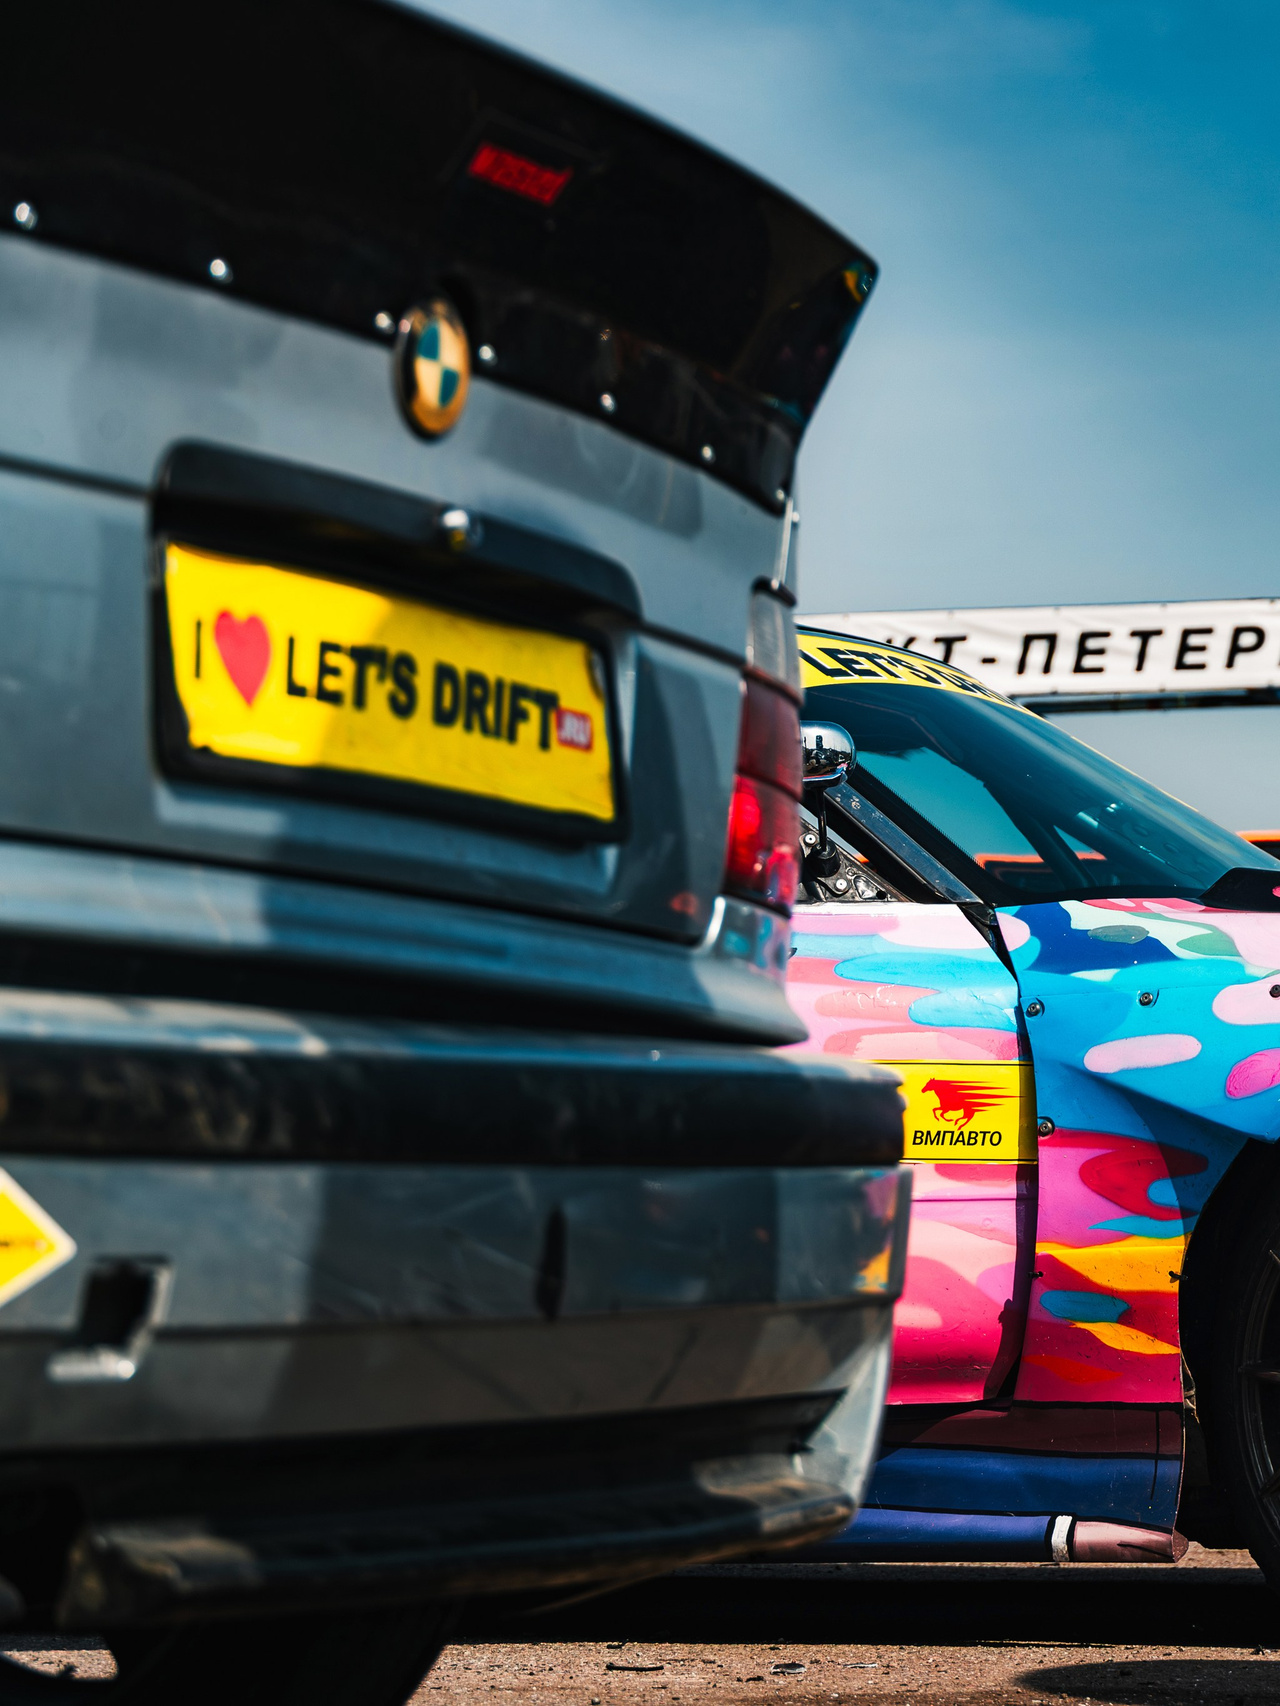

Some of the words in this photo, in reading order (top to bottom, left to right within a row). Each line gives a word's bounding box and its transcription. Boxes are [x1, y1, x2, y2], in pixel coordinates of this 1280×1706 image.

[195, 619, 202, 680] I
[286, 635, 419, 721] LET'S
[911, 1130, 1003, 1147] ВМПАВТО
